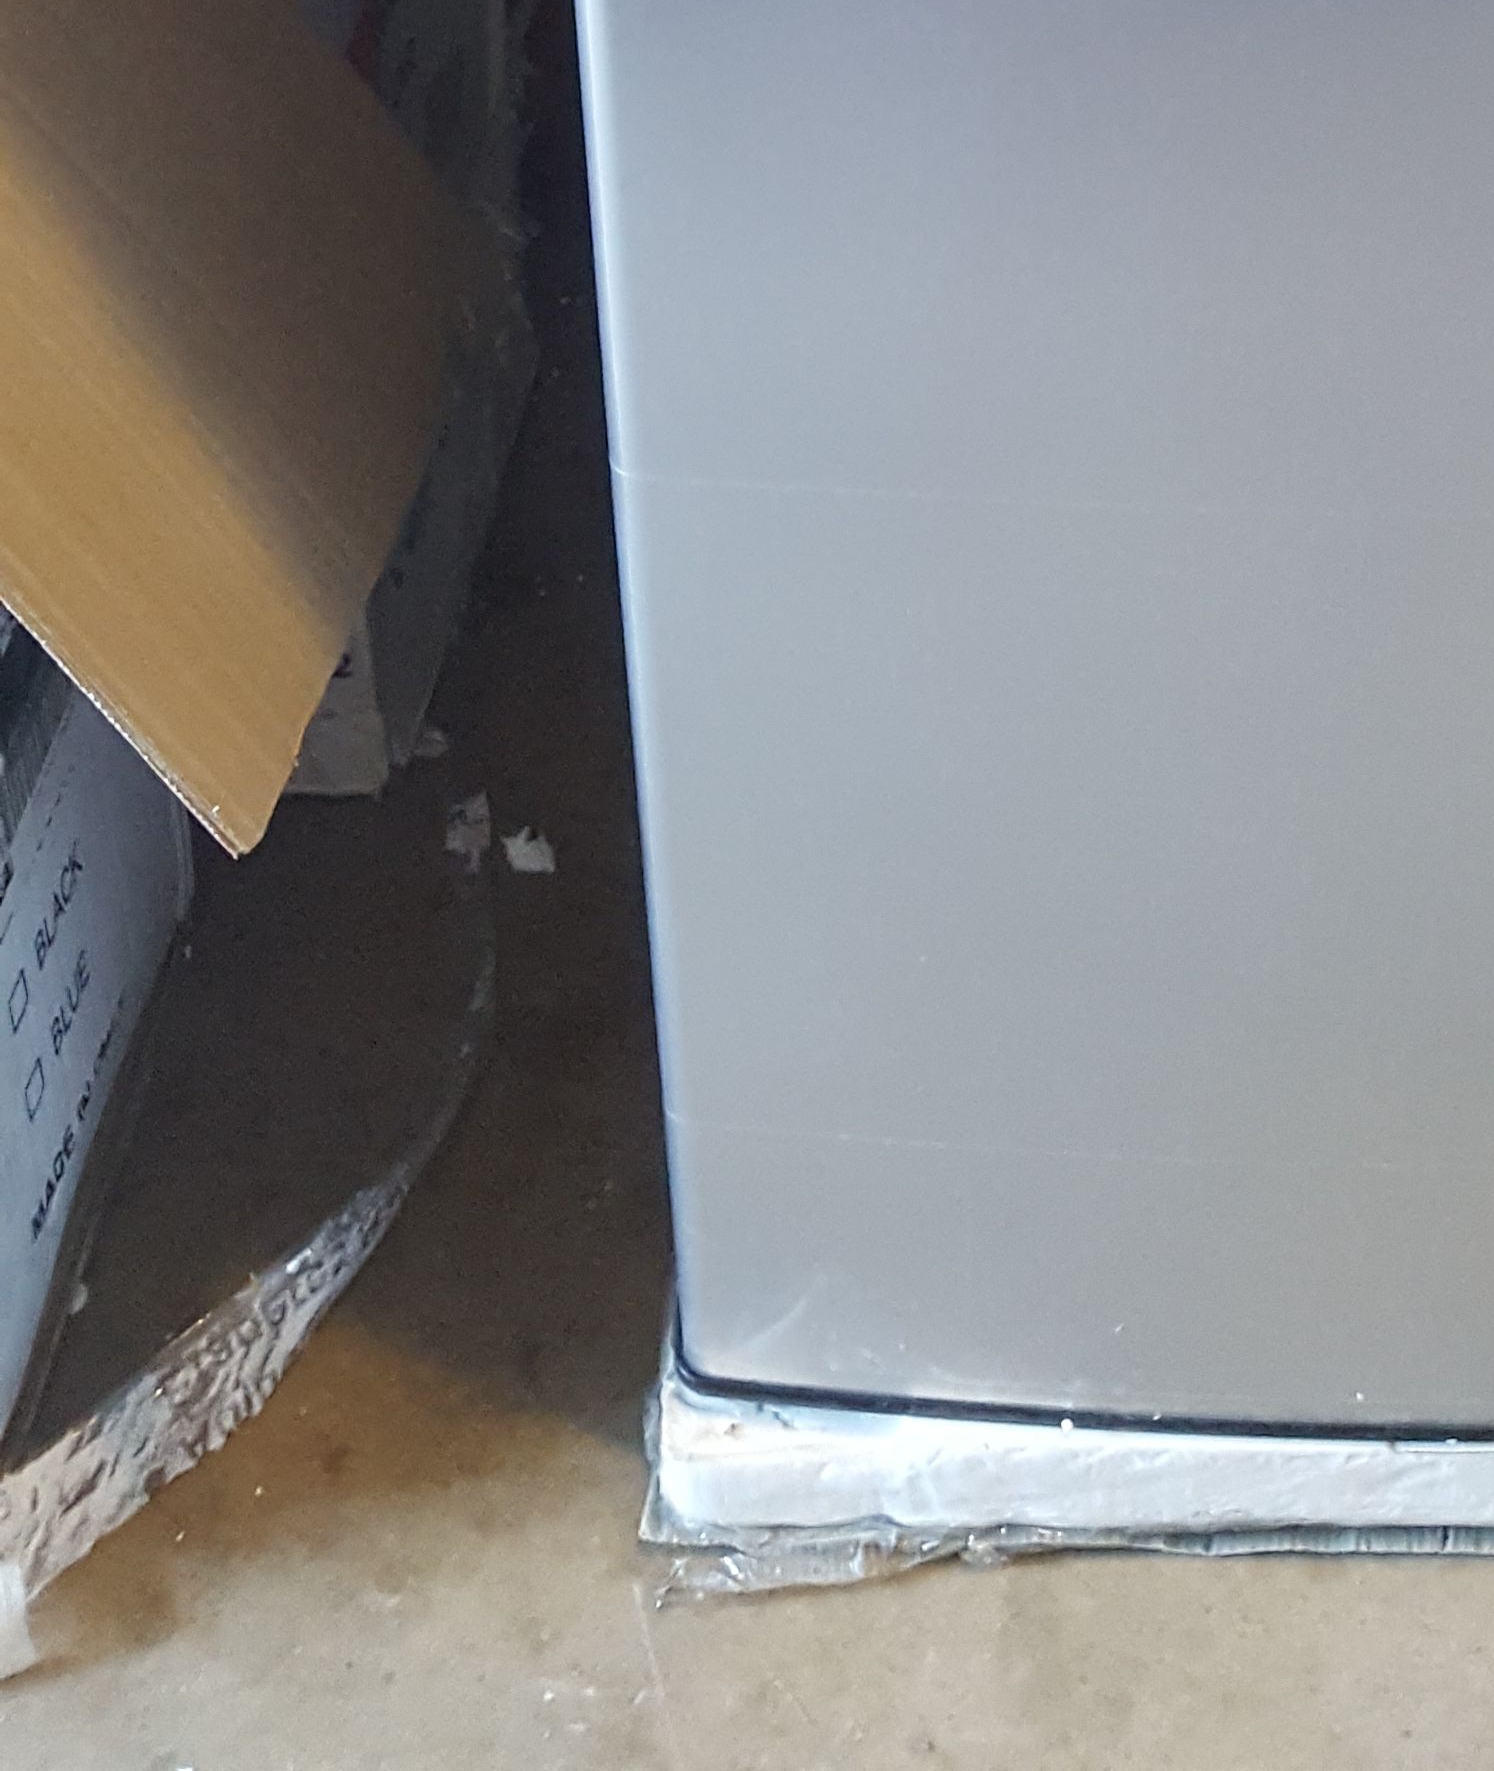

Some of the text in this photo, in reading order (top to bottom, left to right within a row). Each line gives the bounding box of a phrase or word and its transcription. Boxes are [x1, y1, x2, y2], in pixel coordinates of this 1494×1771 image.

[33, 837, 85, 971] BLACK
[51, 948, 92, 1057] BLUE
[30, 1123, 76, 1242] MADE
